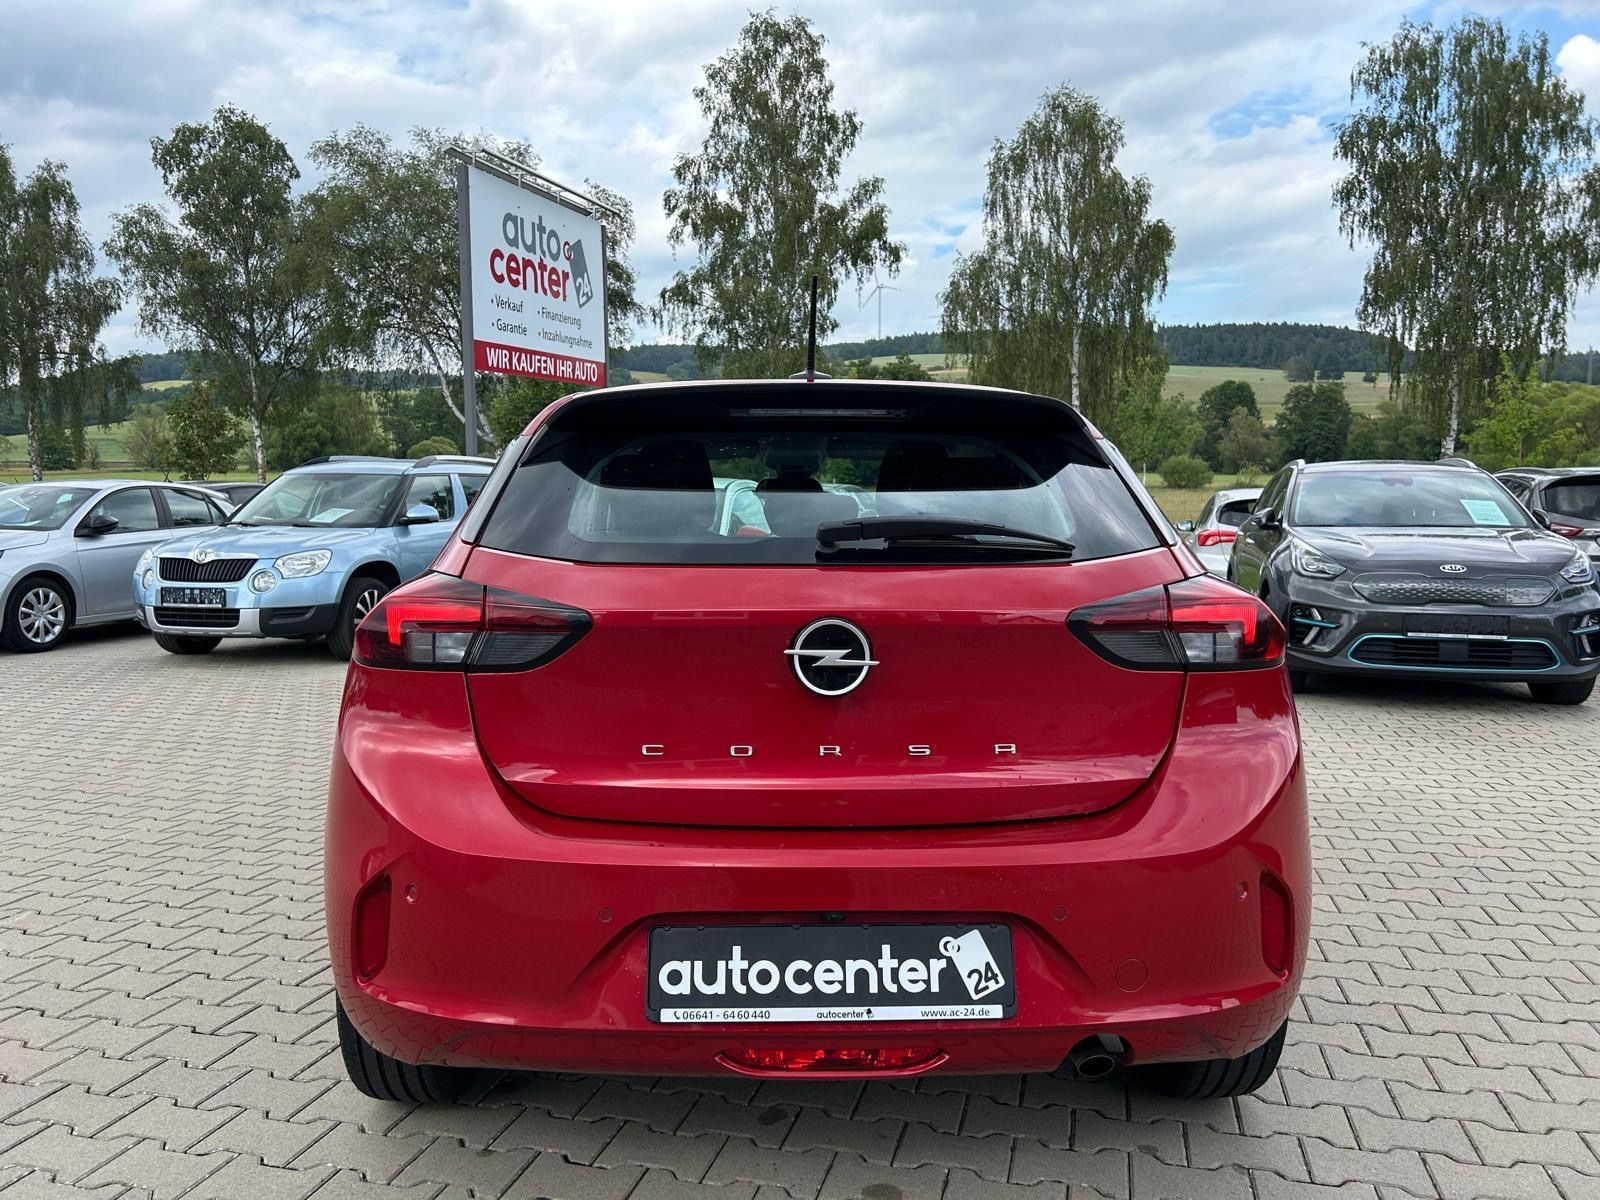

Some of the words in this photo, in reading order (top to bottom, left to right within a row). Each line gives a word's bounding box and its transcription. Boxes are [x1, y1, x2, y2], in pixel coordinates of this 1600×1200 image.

[503, 212, 561, 261] auto
[490, 248, 569, 301] center
[575, 276, 592, 302] 24
[495, 294, 524, 313] Verkauf
[496, 319, 527, 335] Garantie
[541, 307, 581, 329] Finanzierung
[542, 328, 592, 348] Inzahlungnahme
[486, 347, 509, 369] WIR
[512, 352, 554, 375] KAUFEN
[557, 360, 573, 378] IHR
[575, 361, 598, 382] AUTO
[641, 743, 1016, 756] CORSA
[658, 944, 946, 995] autocenter
[966, 961, 1000, 996] 24
[682, 1010, 713, 1019] 06641
[817, 1010, 864, 1018] autocenter
[921, 1008, 990, 1017] www.ac-24.de
